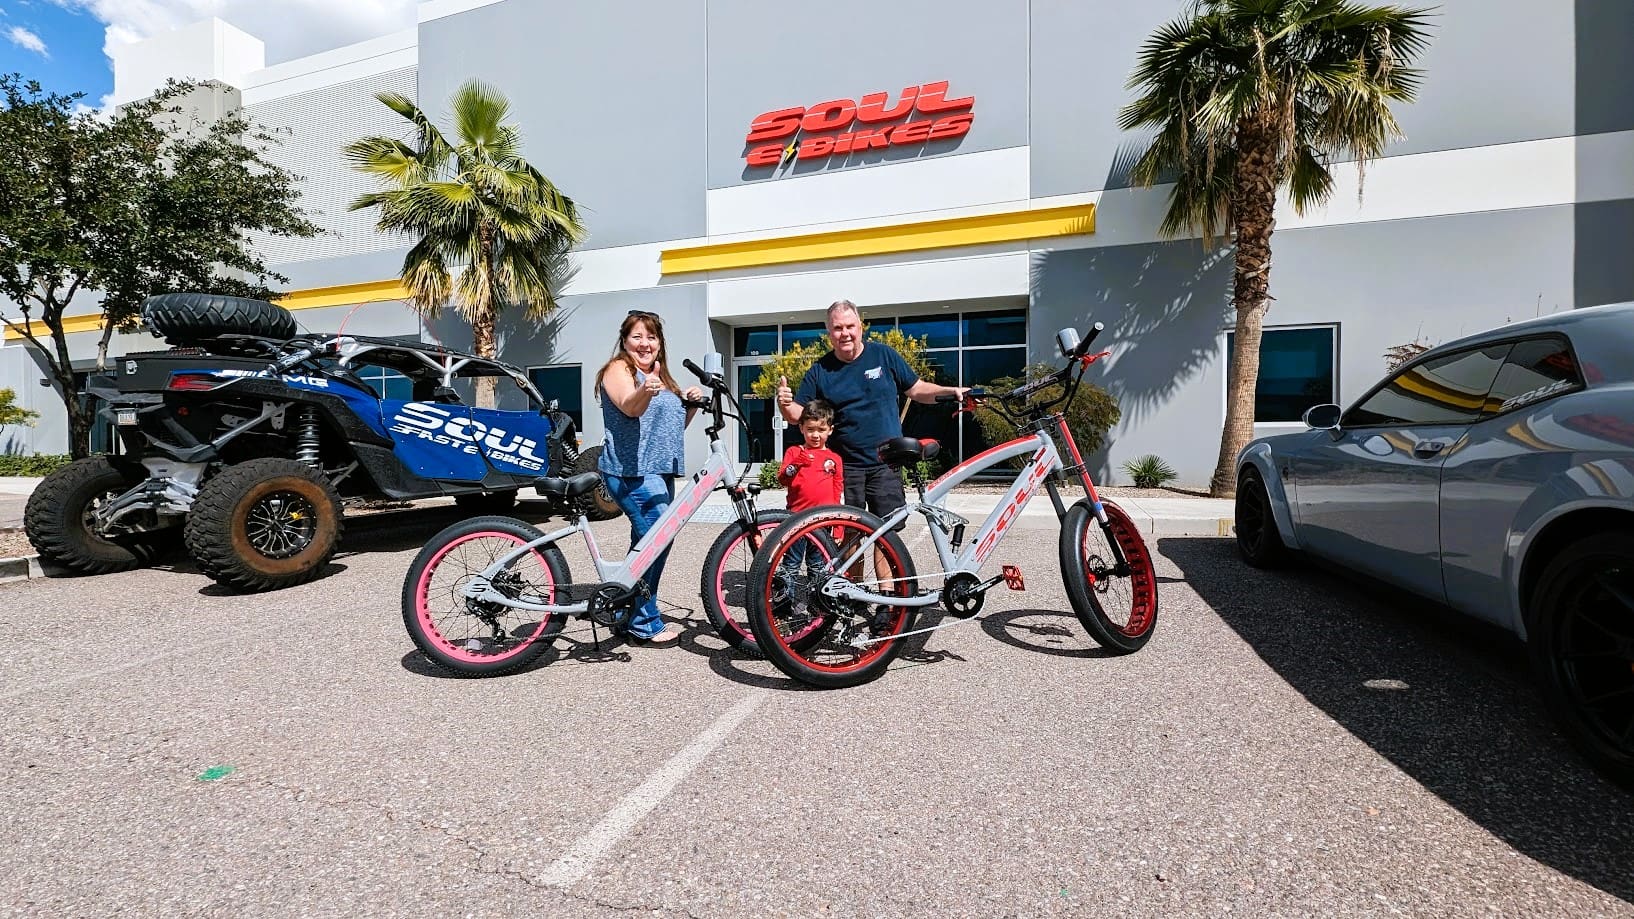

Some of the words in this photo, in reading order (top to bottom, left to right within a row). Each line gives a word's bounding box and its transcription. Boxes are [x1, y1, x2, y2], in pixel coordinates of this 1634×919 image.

[746, 80, 975, 144] SOUL
[797, 113, 975, 160] BIKES
[389, 423, 466, 449] FAST
[394, 402, 545, 464] SOUL
[629, 465, 726, 576] SOUL
[975, 455, 1055, 563] SOUL
